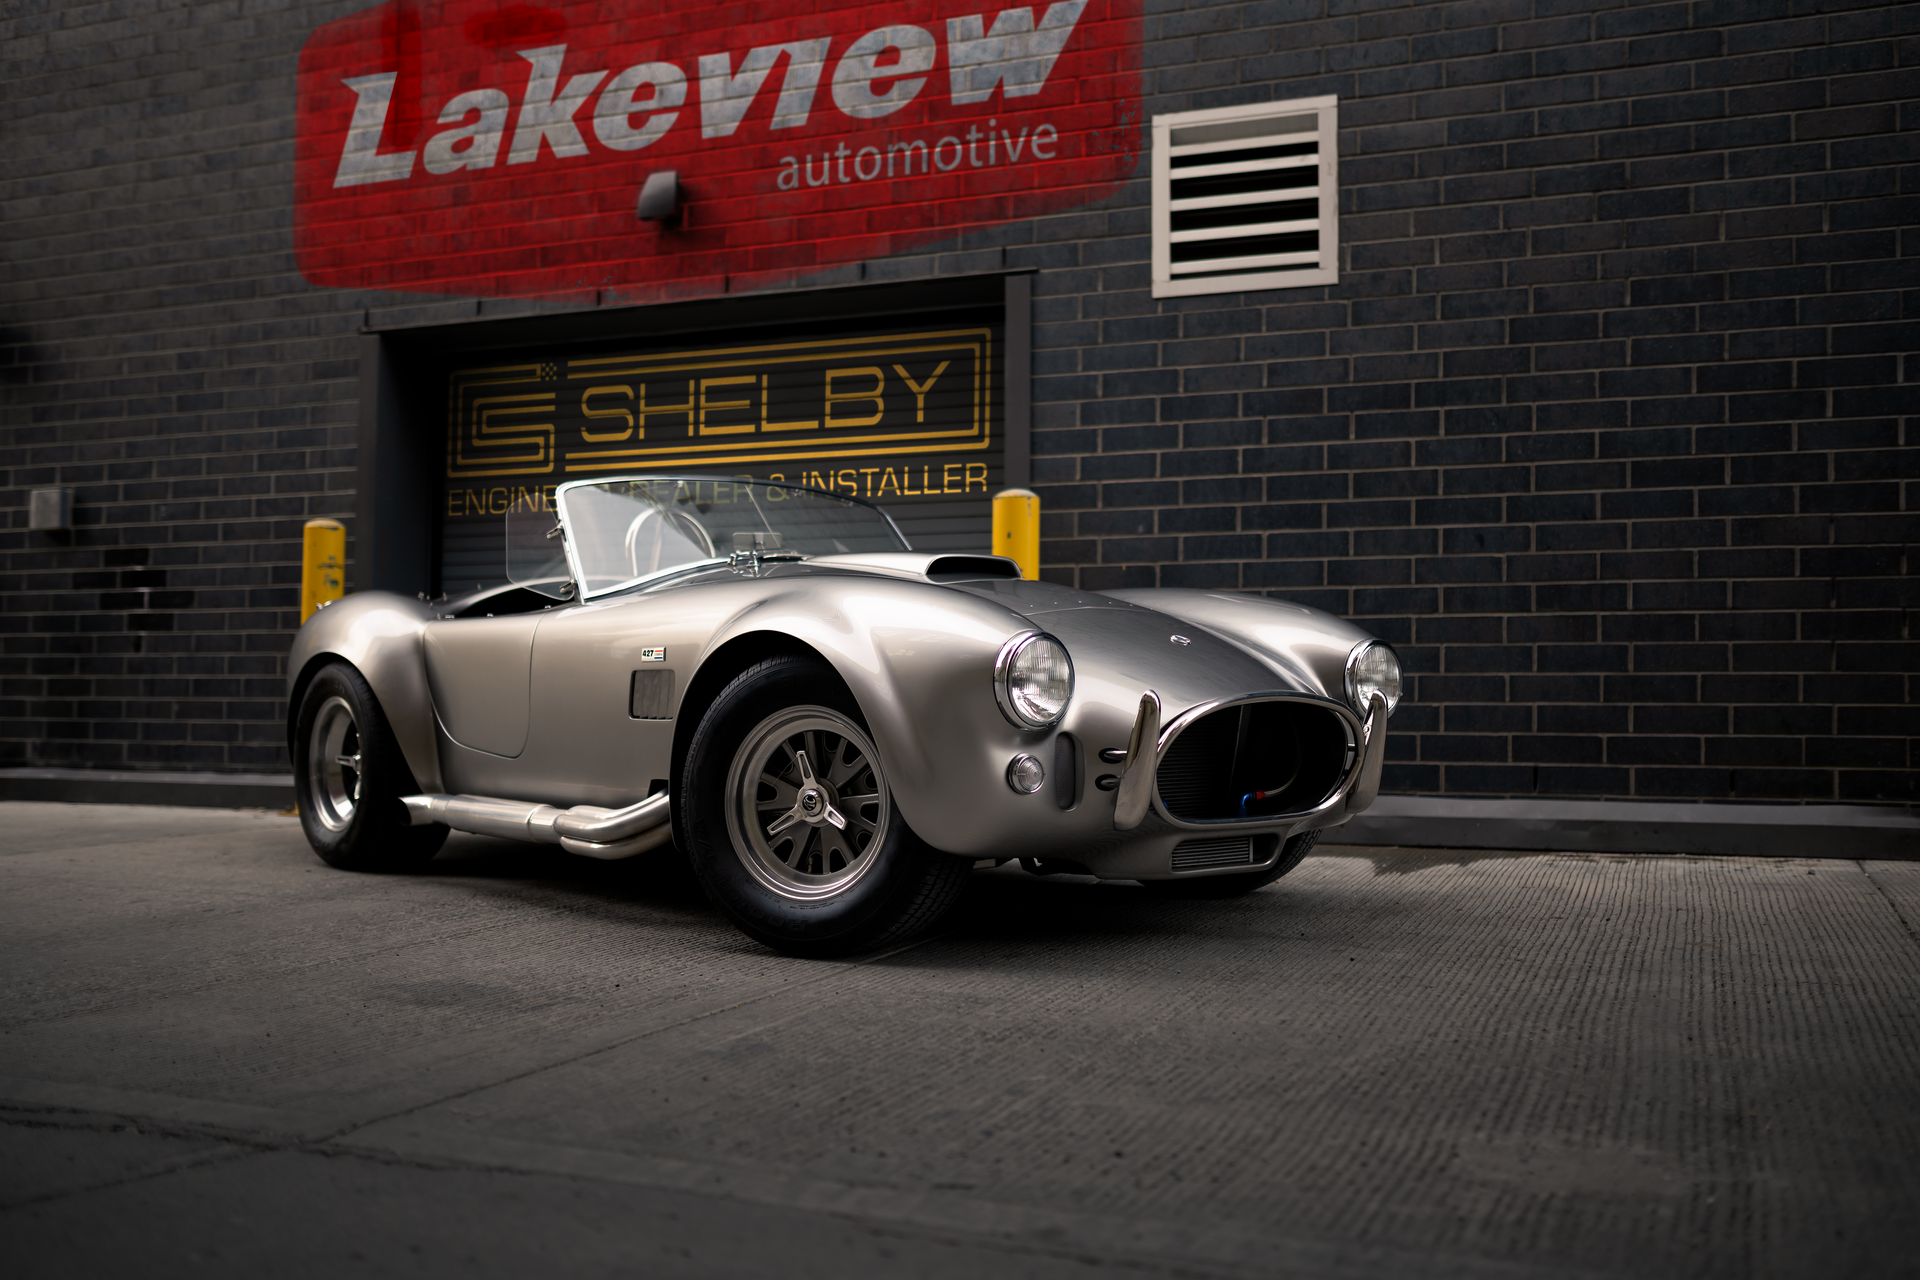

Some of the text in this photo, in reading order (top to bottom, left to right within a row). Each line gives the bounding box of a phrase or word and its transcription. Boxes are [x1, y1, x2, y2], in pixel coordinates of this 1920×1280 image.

[333, 0, 1088, 189] Lakeview
[776, 118, 1059, 191] automotive
[580, 360, 952, 443] SHELBY
[448, 481, 610, 517] ENGINE
[766, 473, 790, 502] &
[802, 462, 989, 500] INSTALLER
[642, 649, 654, 657] 427
